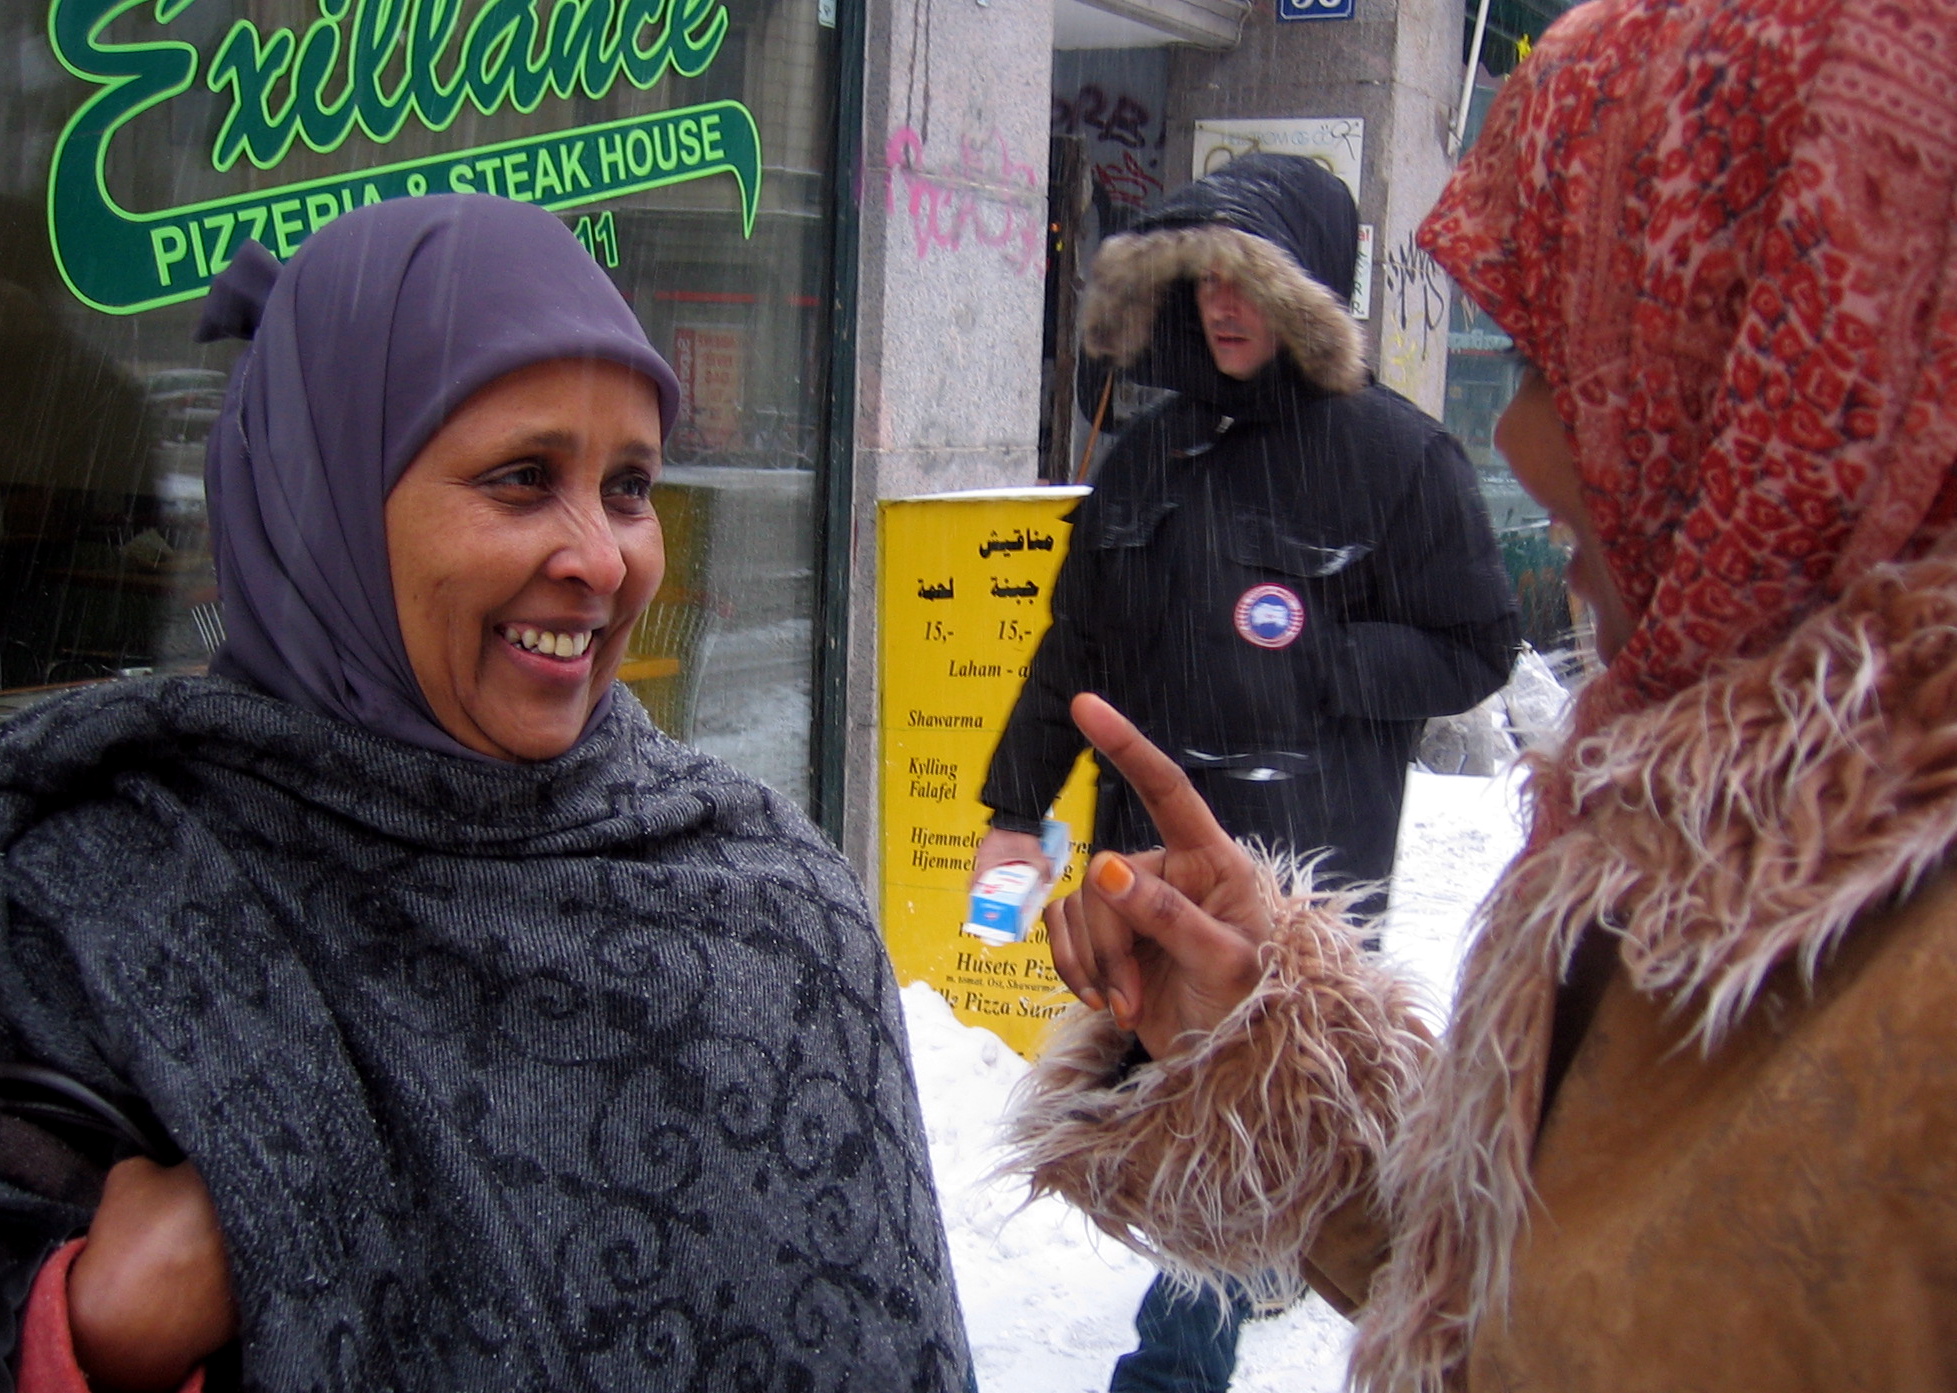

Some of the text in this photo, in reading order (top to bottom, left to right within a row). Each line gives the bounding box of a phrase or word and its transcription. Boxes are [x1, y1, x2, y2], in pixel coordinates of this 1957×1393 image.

[47, 0, 729, 205] Exillance
[450, 140, 592, 202] STEAK
[598, 113, 725, 184] HOUSE
[979, 528, 1054, 559] مناقيش
[991, 576, 1039, 605] جبنة
[925, 621, 954, 642] 15,-
[999, 619, 1032, 642] 15,-
[949, 659, 1001, 678] Laham
[907, 709, 983, 729] Shawarma
[909, 757, 958, 781] Kylling
[909, 780, 957, 804] Falafel
[957, 951, 1018, 977] Husets
[965, 990, 1010, 1016] Pizza
